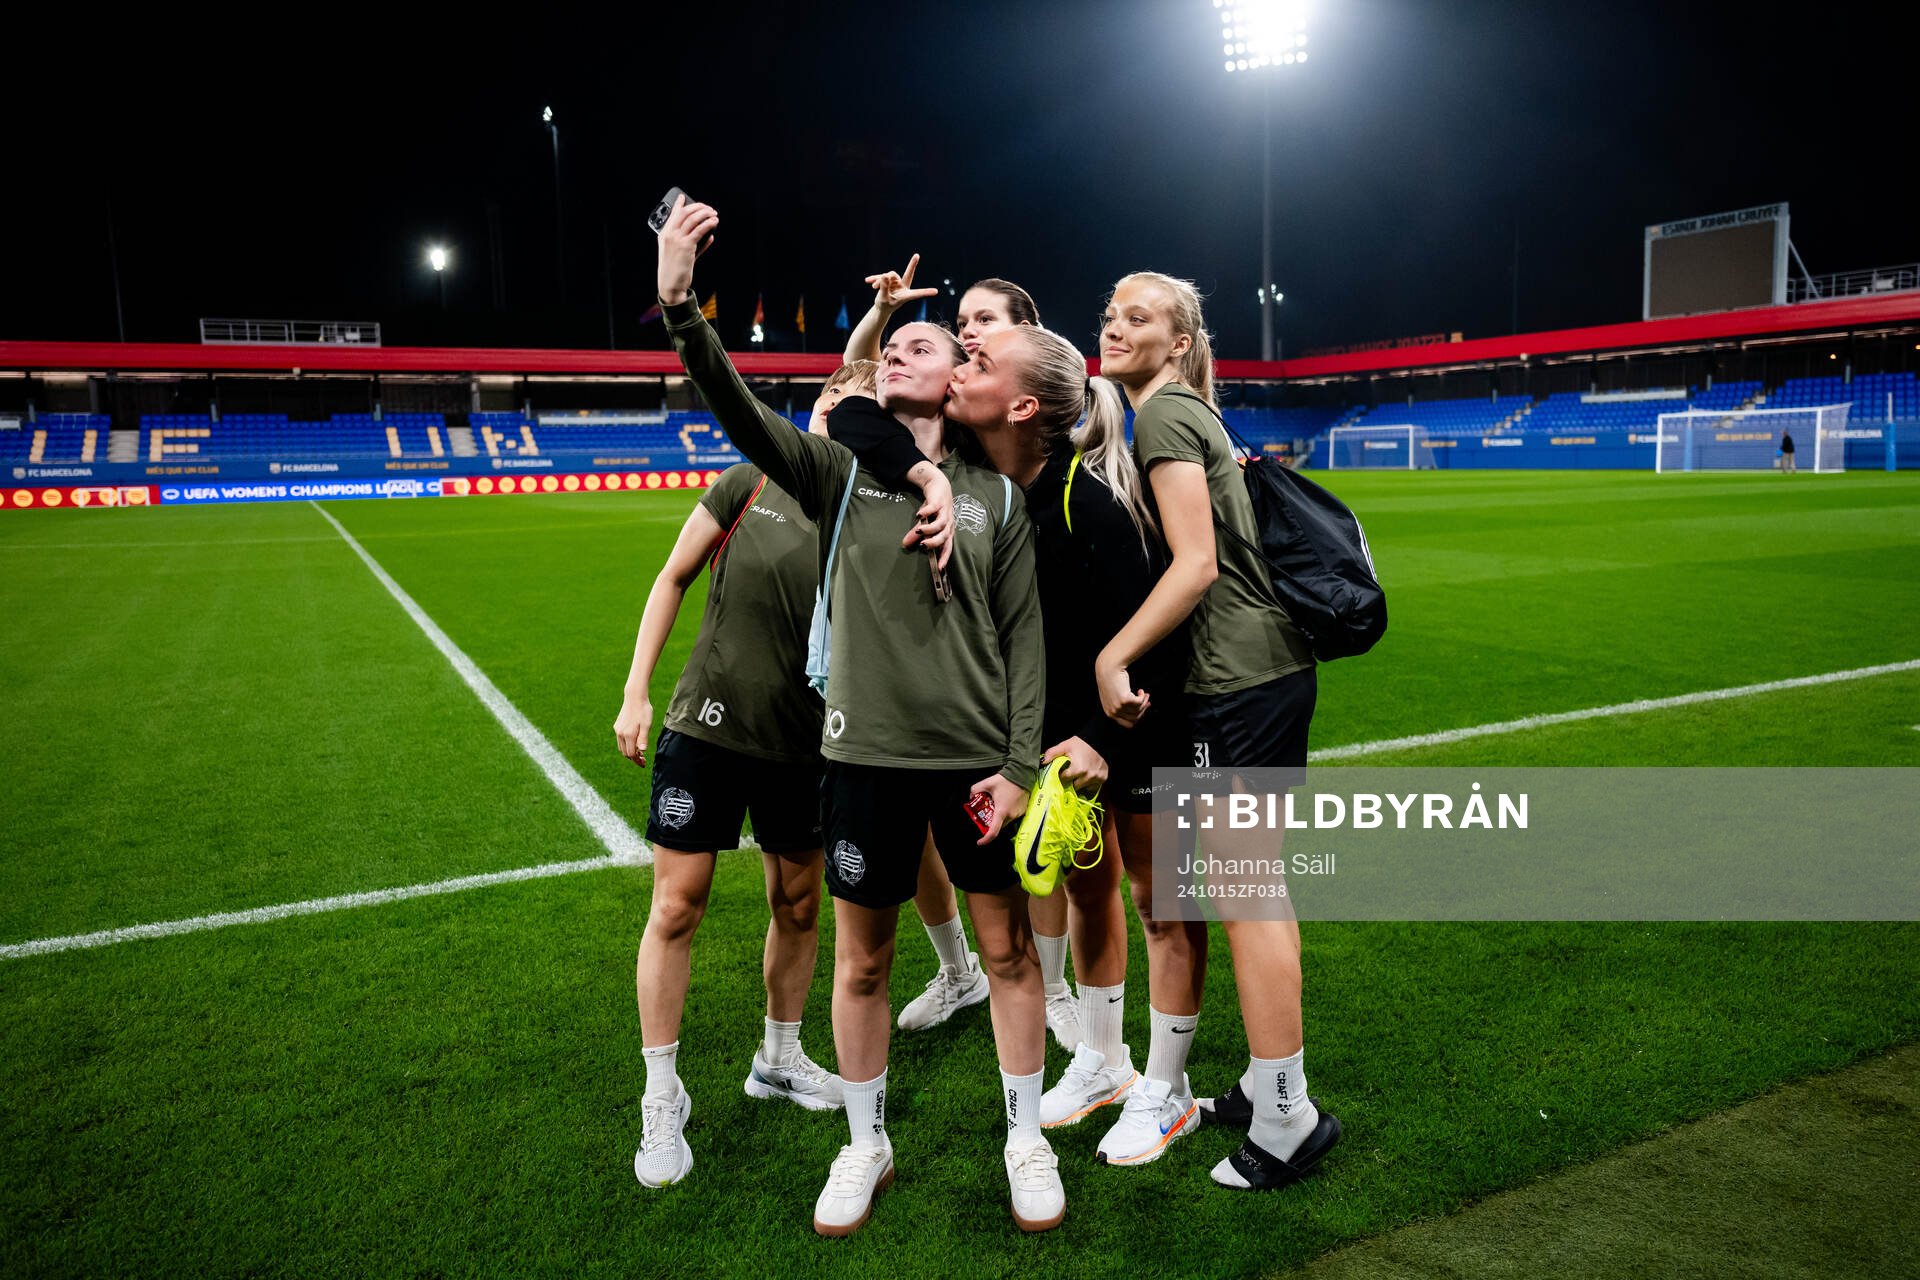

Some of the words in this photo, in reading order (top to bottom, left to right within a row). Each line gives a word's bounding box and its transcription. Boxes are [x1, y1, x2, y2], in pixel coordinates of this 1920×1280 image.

[28, 468, 39, 478] FC
[40, 467, 93, 478] BARCELONA
[293, 463, 339, 472] BARCELONA
[183, 488, 219, 500] UEFA
[221, 485, 287, 499] WOMEN'S
[290, 482, 372, 497] CHAMPIONS
[376, 481, 424, 495] LEAGUE
[858, 487, 894, 500] CRAFT
[697, 697, 725, 727] 16
[825, 709, 845, 739] 10
[1194, 742, 1210, 768] 31
[1131, 784, 1165, 796] CRAFT
[1276, 1071, 1288, 1101] CRAFT
[875, 1089, 884, 1121] CRAFT
[1007, 1088, 1017, 1119] CRAFT
